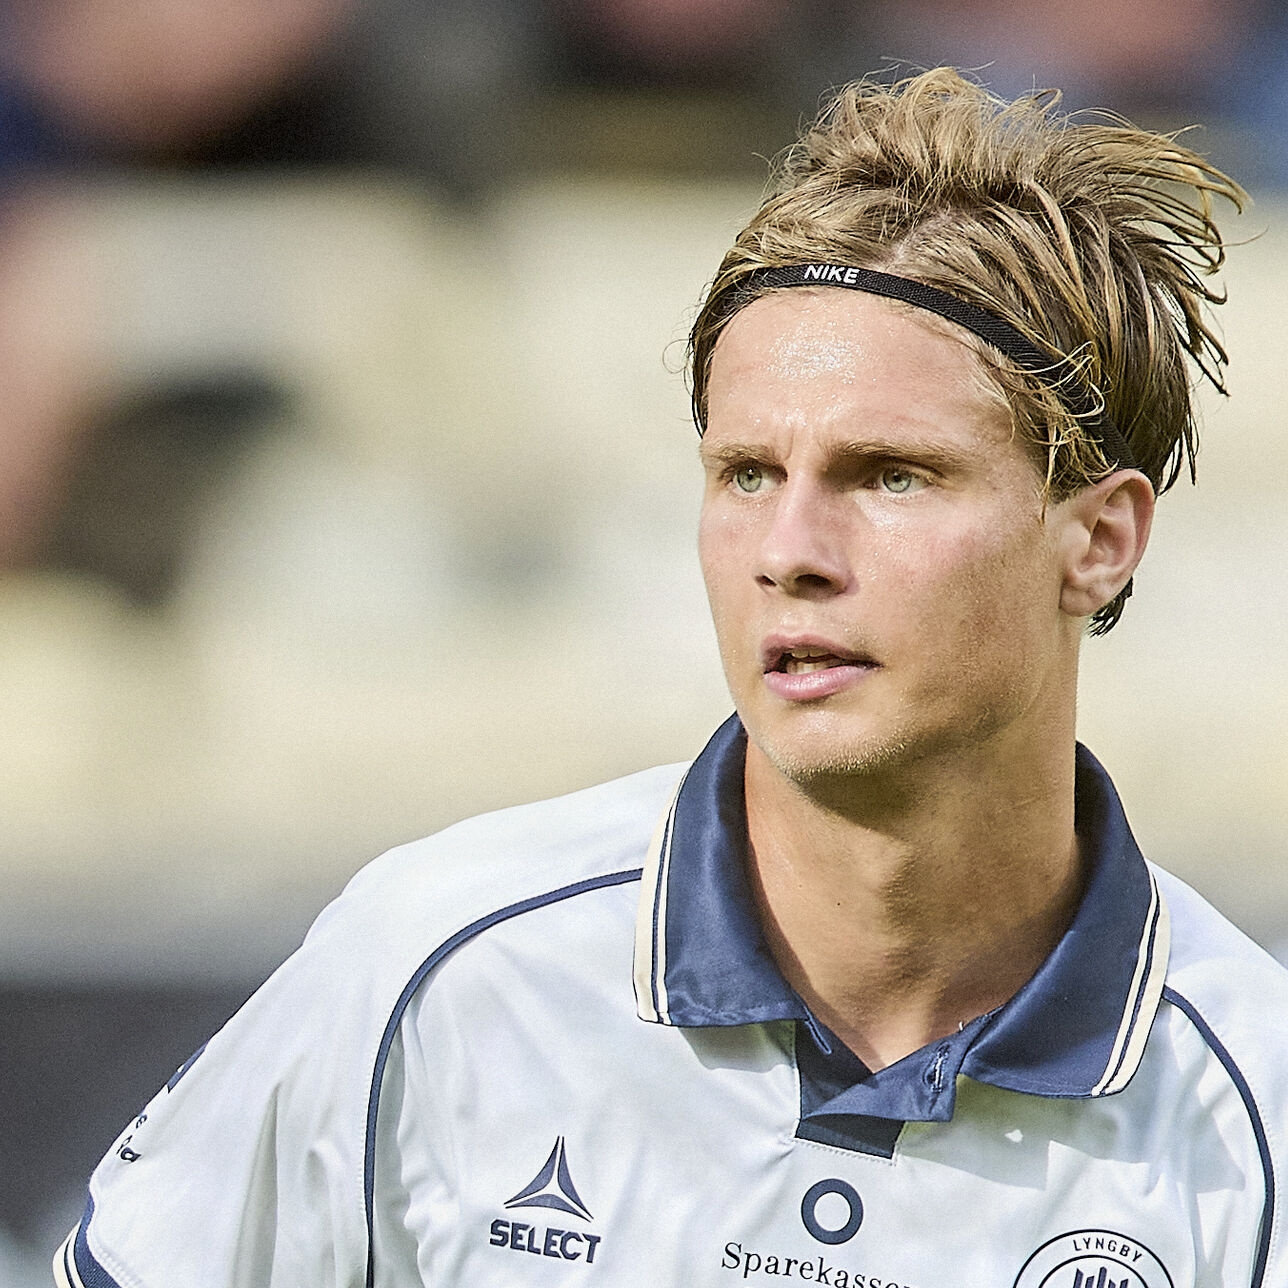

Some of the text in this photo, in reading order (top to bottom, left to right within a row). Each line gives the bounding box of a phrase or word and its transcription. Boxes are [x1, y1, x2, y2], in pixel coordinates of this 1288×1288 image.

[803, 264, 861, 284] NIKE
[489, 1219, 601, 1264] SELECT
[1073, 1237, 1142, 1262] LYNGBY
